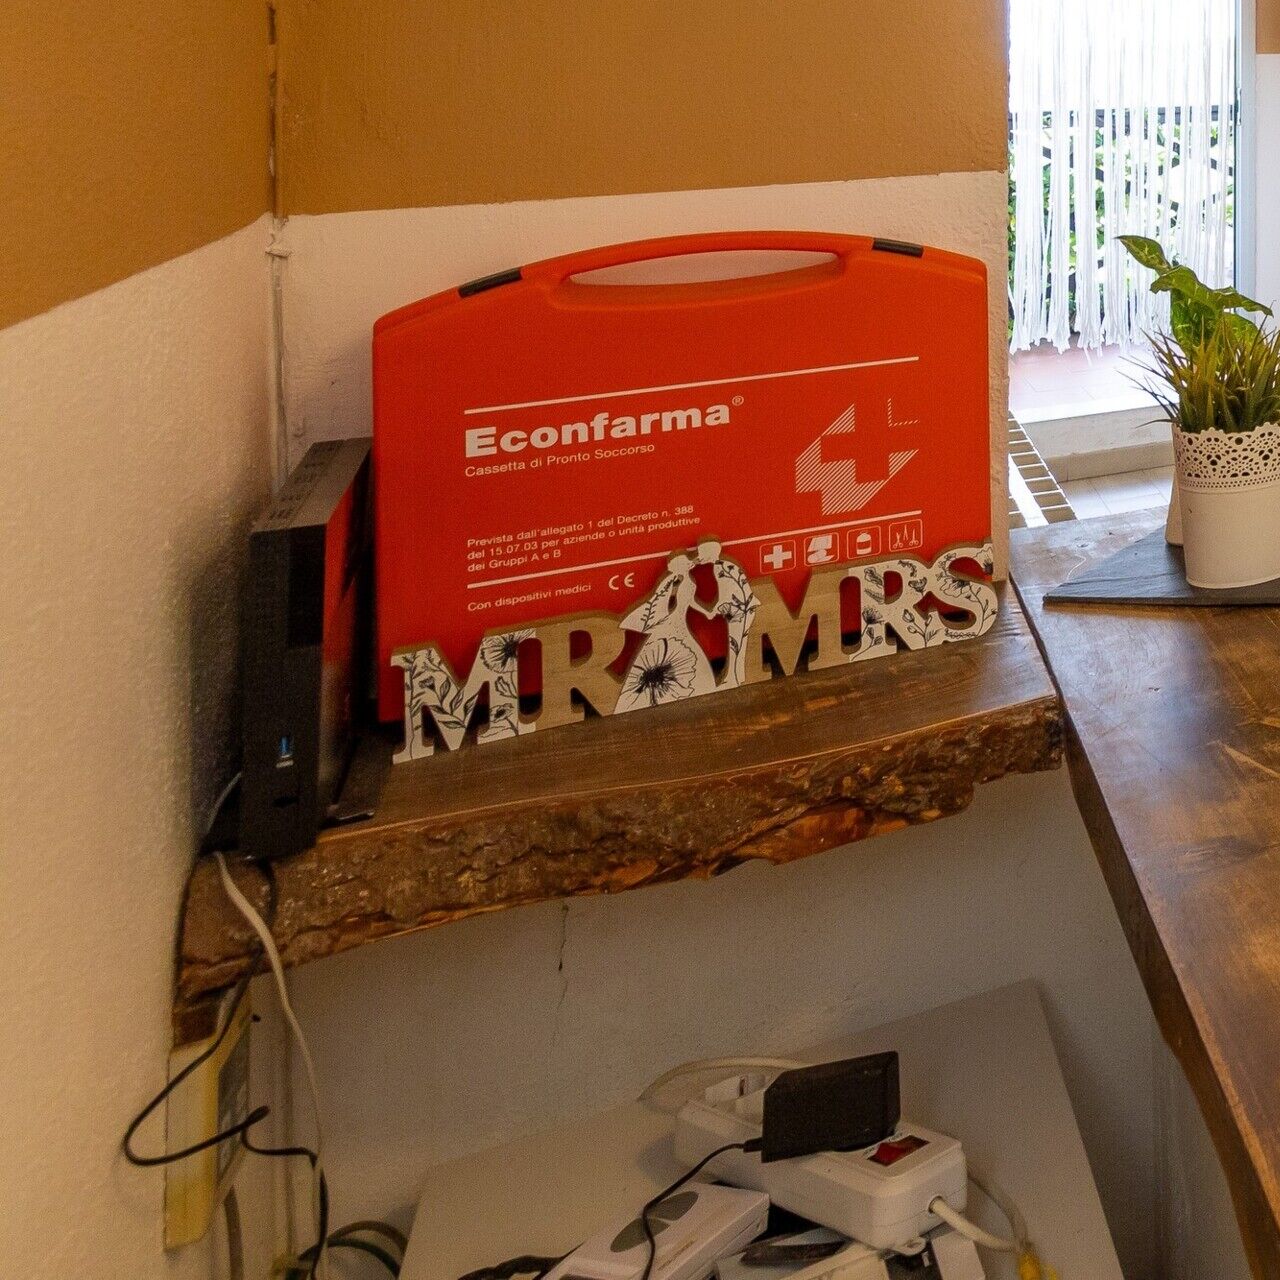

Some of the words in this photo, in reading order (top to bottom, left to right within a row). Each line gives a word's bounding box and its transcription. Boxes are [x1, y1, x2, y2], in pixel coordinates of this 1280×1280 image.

[465, 460, 526, 477] Cassetta
[530, 458, 543, 468] di
[547, 451, 590, 466] Pronto
[595, 443, 655, 460] Soccorso
[467, 533, 514, 548] Prevista
[588, 521, 594, 529] 1
[597, 518, 614, 528] del
[617, 511, 659, 525] Decreto
[661, 509, 670, 517] n.
[675, 505, 694, 515] 388
[467, 551, 485, 560] del
[489, 542, 538, 556] 15.07.03
[541, 539, 559, 551] per
[563, 532, 605, 546] aziende
[619, 524, 645, 536] unità
[648, 517, 700, 533] produttive
[467, 562, 485, 572] dei
[489, 556, 528, 570] Gruppi
[531, 553, 539, 562] A
[542, 552, 550, 560] e
[553, 549, 561, 558] B
[467, 601, 492, 611] Con
[495, 590, 551, 607] dispositivi
[555, 584, 592, 596] medici
